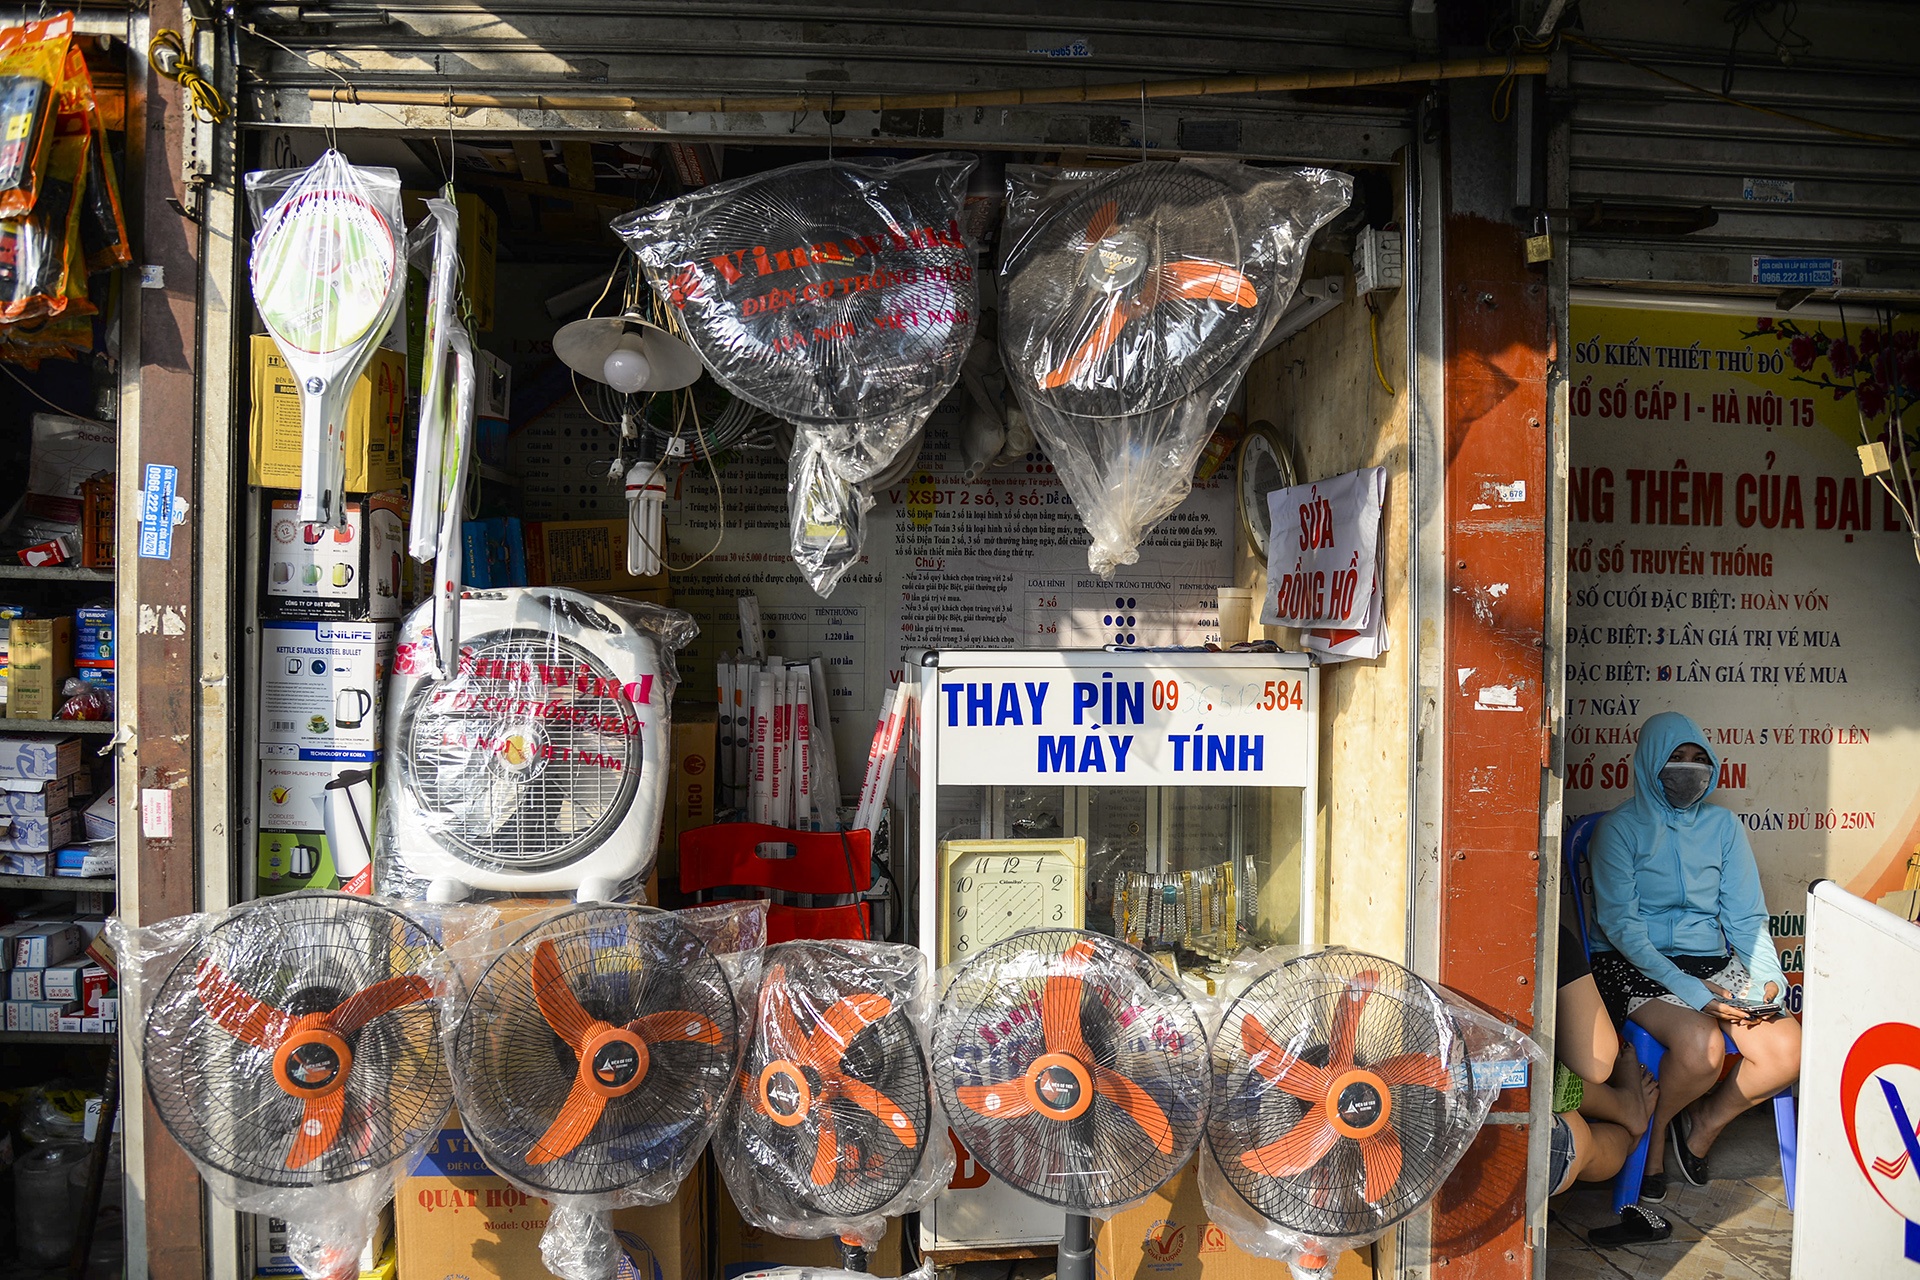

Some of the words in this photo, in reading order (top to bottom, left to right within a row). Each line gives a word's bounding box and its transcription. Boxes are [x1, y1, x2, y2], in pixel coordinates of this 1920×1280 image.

[742, 289, 796, 316] ĐIỆN
[803, 282, 836, 300] CƠ
[840, 265, 917, 295] THỐNG
[924, 261, 972, 283] NHẤT
[1762, 273, 1812, 282] 0966.222.811
[772, 331, 808, 353] HÀ
[814, 321, 855, 343] NỘI
[873, 311, 919, 334] VIỆT
[928, 310, 968, 324] NAM
[1576, 334, 1600, 364] SỐ
[1605, 337, 1651, 367] KIẾN
[1655, 340, 1710, 370] THIẾT
[1715, 345, 1754, 373] THỦ
[1758, 348, 1784, 374] ĐÔ
[1598, 379, 1627, 418] SỐ
[1634, 380, 1677, 420] CẤP
[1685, 393, 1690, 421] I
[1713, 388, 1740, 424] HÀ
[1747, 390, 1782, 432] NỘI
[1790, 399, 1814, 427] 15
[78, 431, 101, 441] Rice
[145, 467, 161, 533] 0966.222.811
[889, 491, 903, 504] V.
[909, 491, 955, 504] XSĐT
[960, 491, 969, 504] 2
[975, 489, 999, 507] số,
[1005, 492, 1014, 505] 3
[1019, 489, 1044, 505] số:
[1046, 491, 1059, 504] Dễ
[1627, 459, 1723, 526] THÊM
[1736, 451, 1804, 529] CỦA
[1815, 476, 1871, 543] ĐẠI
[896, 508, 905, 518] Xổ
[907, 508, 916, 518] Số
[917, 510, 932, 520] Điện
[934, 510, 950, 518] Toán
[957, 508, 965, 519] số
[966, 510, 972, 519] là
[974, 510, 985, 521] loại
[987, 509, 1002, 519] hình
[1004, 508, 1012, 519] xổ
[1013, 509, 1021, 519] số
[1022, 511, 1037, 521] chọn
[1039, 509, 1055, 521] bằng
[1057, 510, 1073, 521] máy,
[1298, 485, 1334, 552] SỬA
[143, 533, 157, 555] 24/24
[915, 557, 933, 567] Chú
[937, 557, 945, 570] ý:
[1598, 541, 1624, 573] SỐ
[1631, 542, 1703, 576] TRUYỀN
[1711, 544, 1772, 577] THỐNG
[1029, 580, 1049, 588] LOẠI
[1050, 578, 1065, 587] HÌNH
[1077, 580, 1097, 588] ĐIỀU
[1098, 579, 1115, 589] KIỆN
[1116, 580, 1139, 588] TRÚNG
[1141, 581, 1171, 590] THƯỞNG
[1277, 556, 1326, 618] ĐỒNG
[1328, 551, 1358, 621] HỒ
[1039, 598, 1044, 607] 2
[1047, 596, 1057, 607] số
[1576, 584, 1603, 608] SỐ
[1604, 585, 1647, 608] CUỐI
[1651, 588, 1687, 611] ĐẶC
[1691, 589, 1736, 612] BIỆT:
[1741, 588, 1789, 610] HOÀN
[1795, 586, 1829, 611] VỐN
[320, 629, 372, 640] UNILIFE
[825, 633, 842, 641] 1.220
[1038, 624, 1043, 633] 3
[1046, 623, 1056, 633] số
[1607, 627, 1652, 647] BIỆT:
[1669, 622, 1704, 646] LẦN
[1709, 625, 1738, 647] GIÁ
[1744, 630, 1772, 650] TRỊ
[1778, 626, 1799, 647] VÉ
[1804, 631, 1841, 648] MUA
[296, 647, 324, 655] STAINLESS
[1606, 664, 1650, 684] BIỆT:
[1676, 659, 1711, 683] LẦN
[1716, 662, 1745, 683] GIÁ
[1750, 667, 1778, 686] TRỊ
[1787, 663, 1805, 683] VÉ
[1810, 667, 1847, 683] MUA
[942, 682, 1050, 727] THAY
[1579, 700, 1586, 715] 7
[1591, 694, 1639, 716] NGÀY
[1717, 729, 1754, 744] MUA
[1760, 729, 1768, 743] 5
[1773, 725, 1794, 744] VÉ
[1799, 724, 1833, 746] TRỞ
[1838, 723, 1870, 745] LÊN
[1038, 724, 1133, 773] MÁY
[1169, 723, 1264, 772] TÍNH
[579, 751, 621, 770] NAM
[1567, 753, 1594, 790] XỔ
[1600, 754, 1629, 789] SỐ
[688, 783, 703, 817] TICO
[1787, 808, 1811, 830] ĐỦ
[1815, 809, 1837, 834] BỘ
[1841, 812, 1875, 830] 250N
[447, 1160, 470, 1172] ĐIỆN
[418, 1189, 478, 1214] QUẠT
[485, 1220, 518, 1230] Model:
